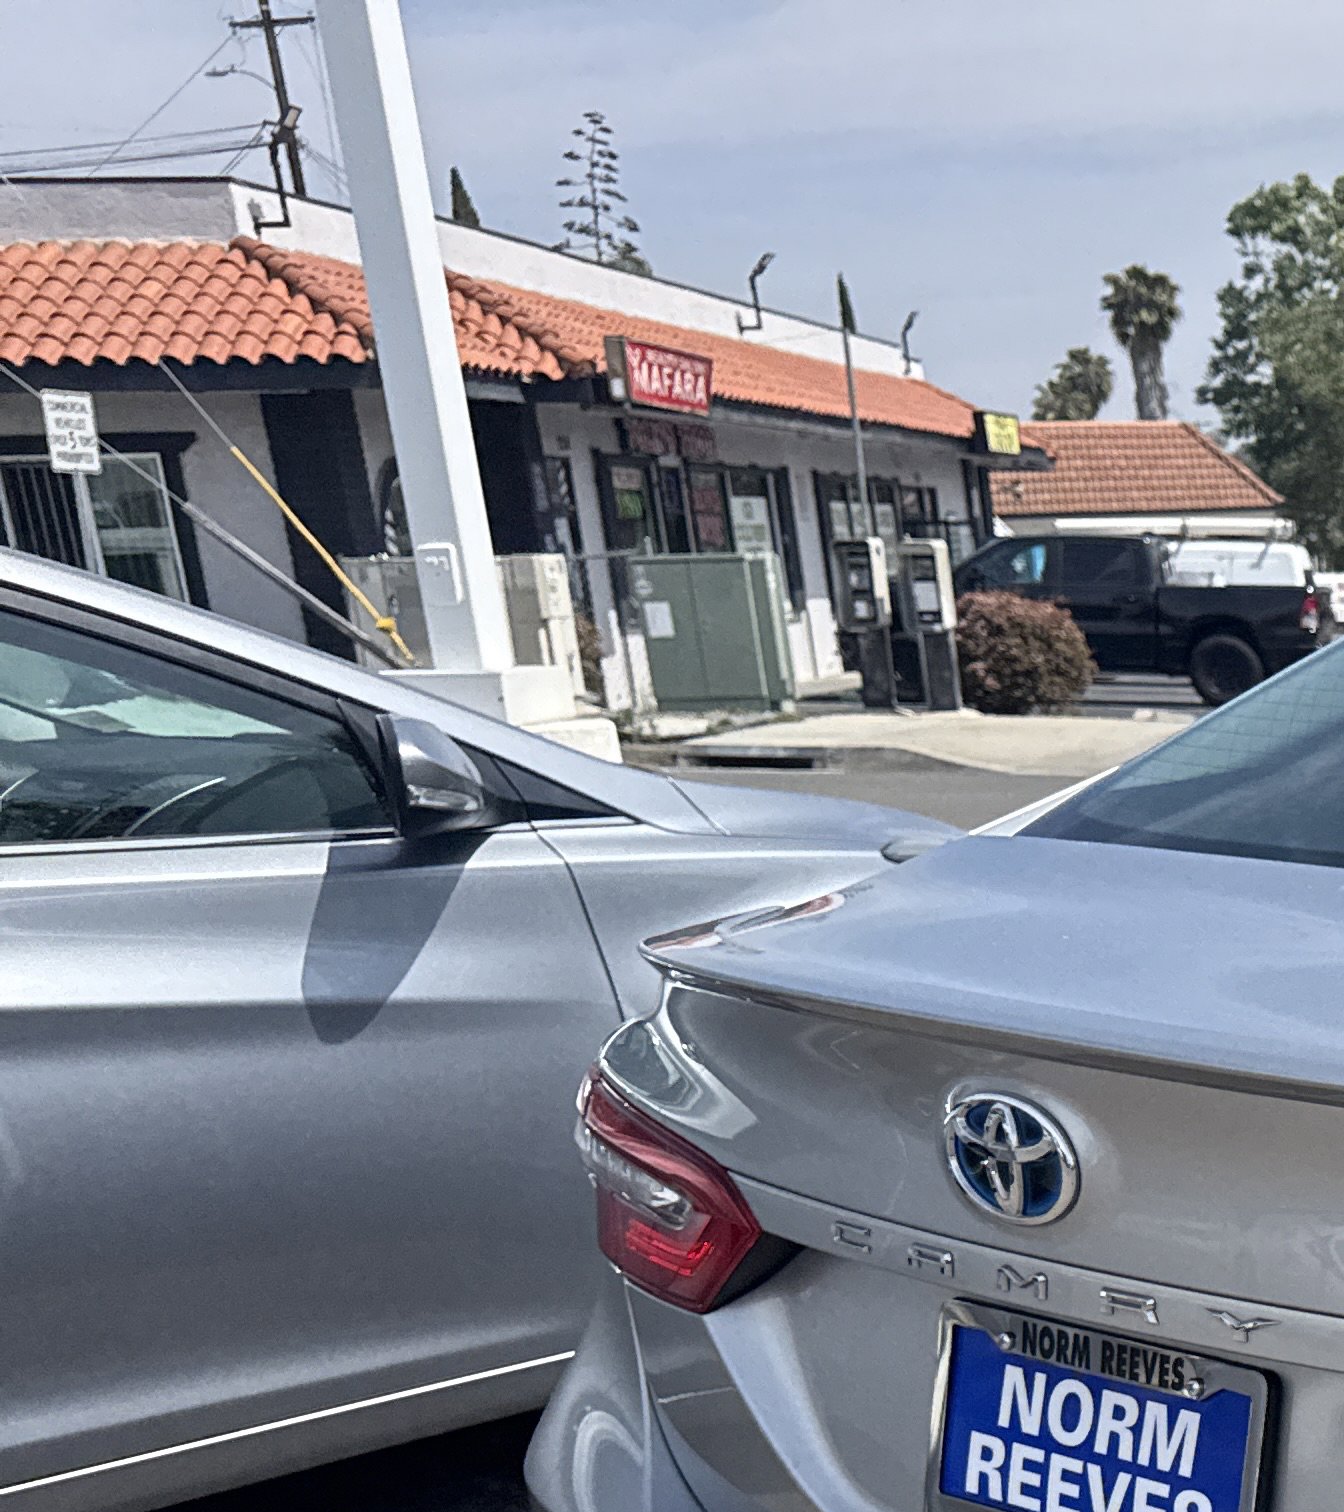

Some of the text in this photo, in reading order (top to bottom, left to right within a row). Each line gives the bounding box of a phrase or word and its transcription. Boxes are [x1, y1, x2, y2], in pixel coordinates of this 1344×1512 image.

[633, 361, 708, 405] MAFARA
[831, 1220, 1281, 1343] CAMRY
[1021, 1321, 1186, 1391] NORM REEVES
[998, 1363, 1201, 1479] NORM
